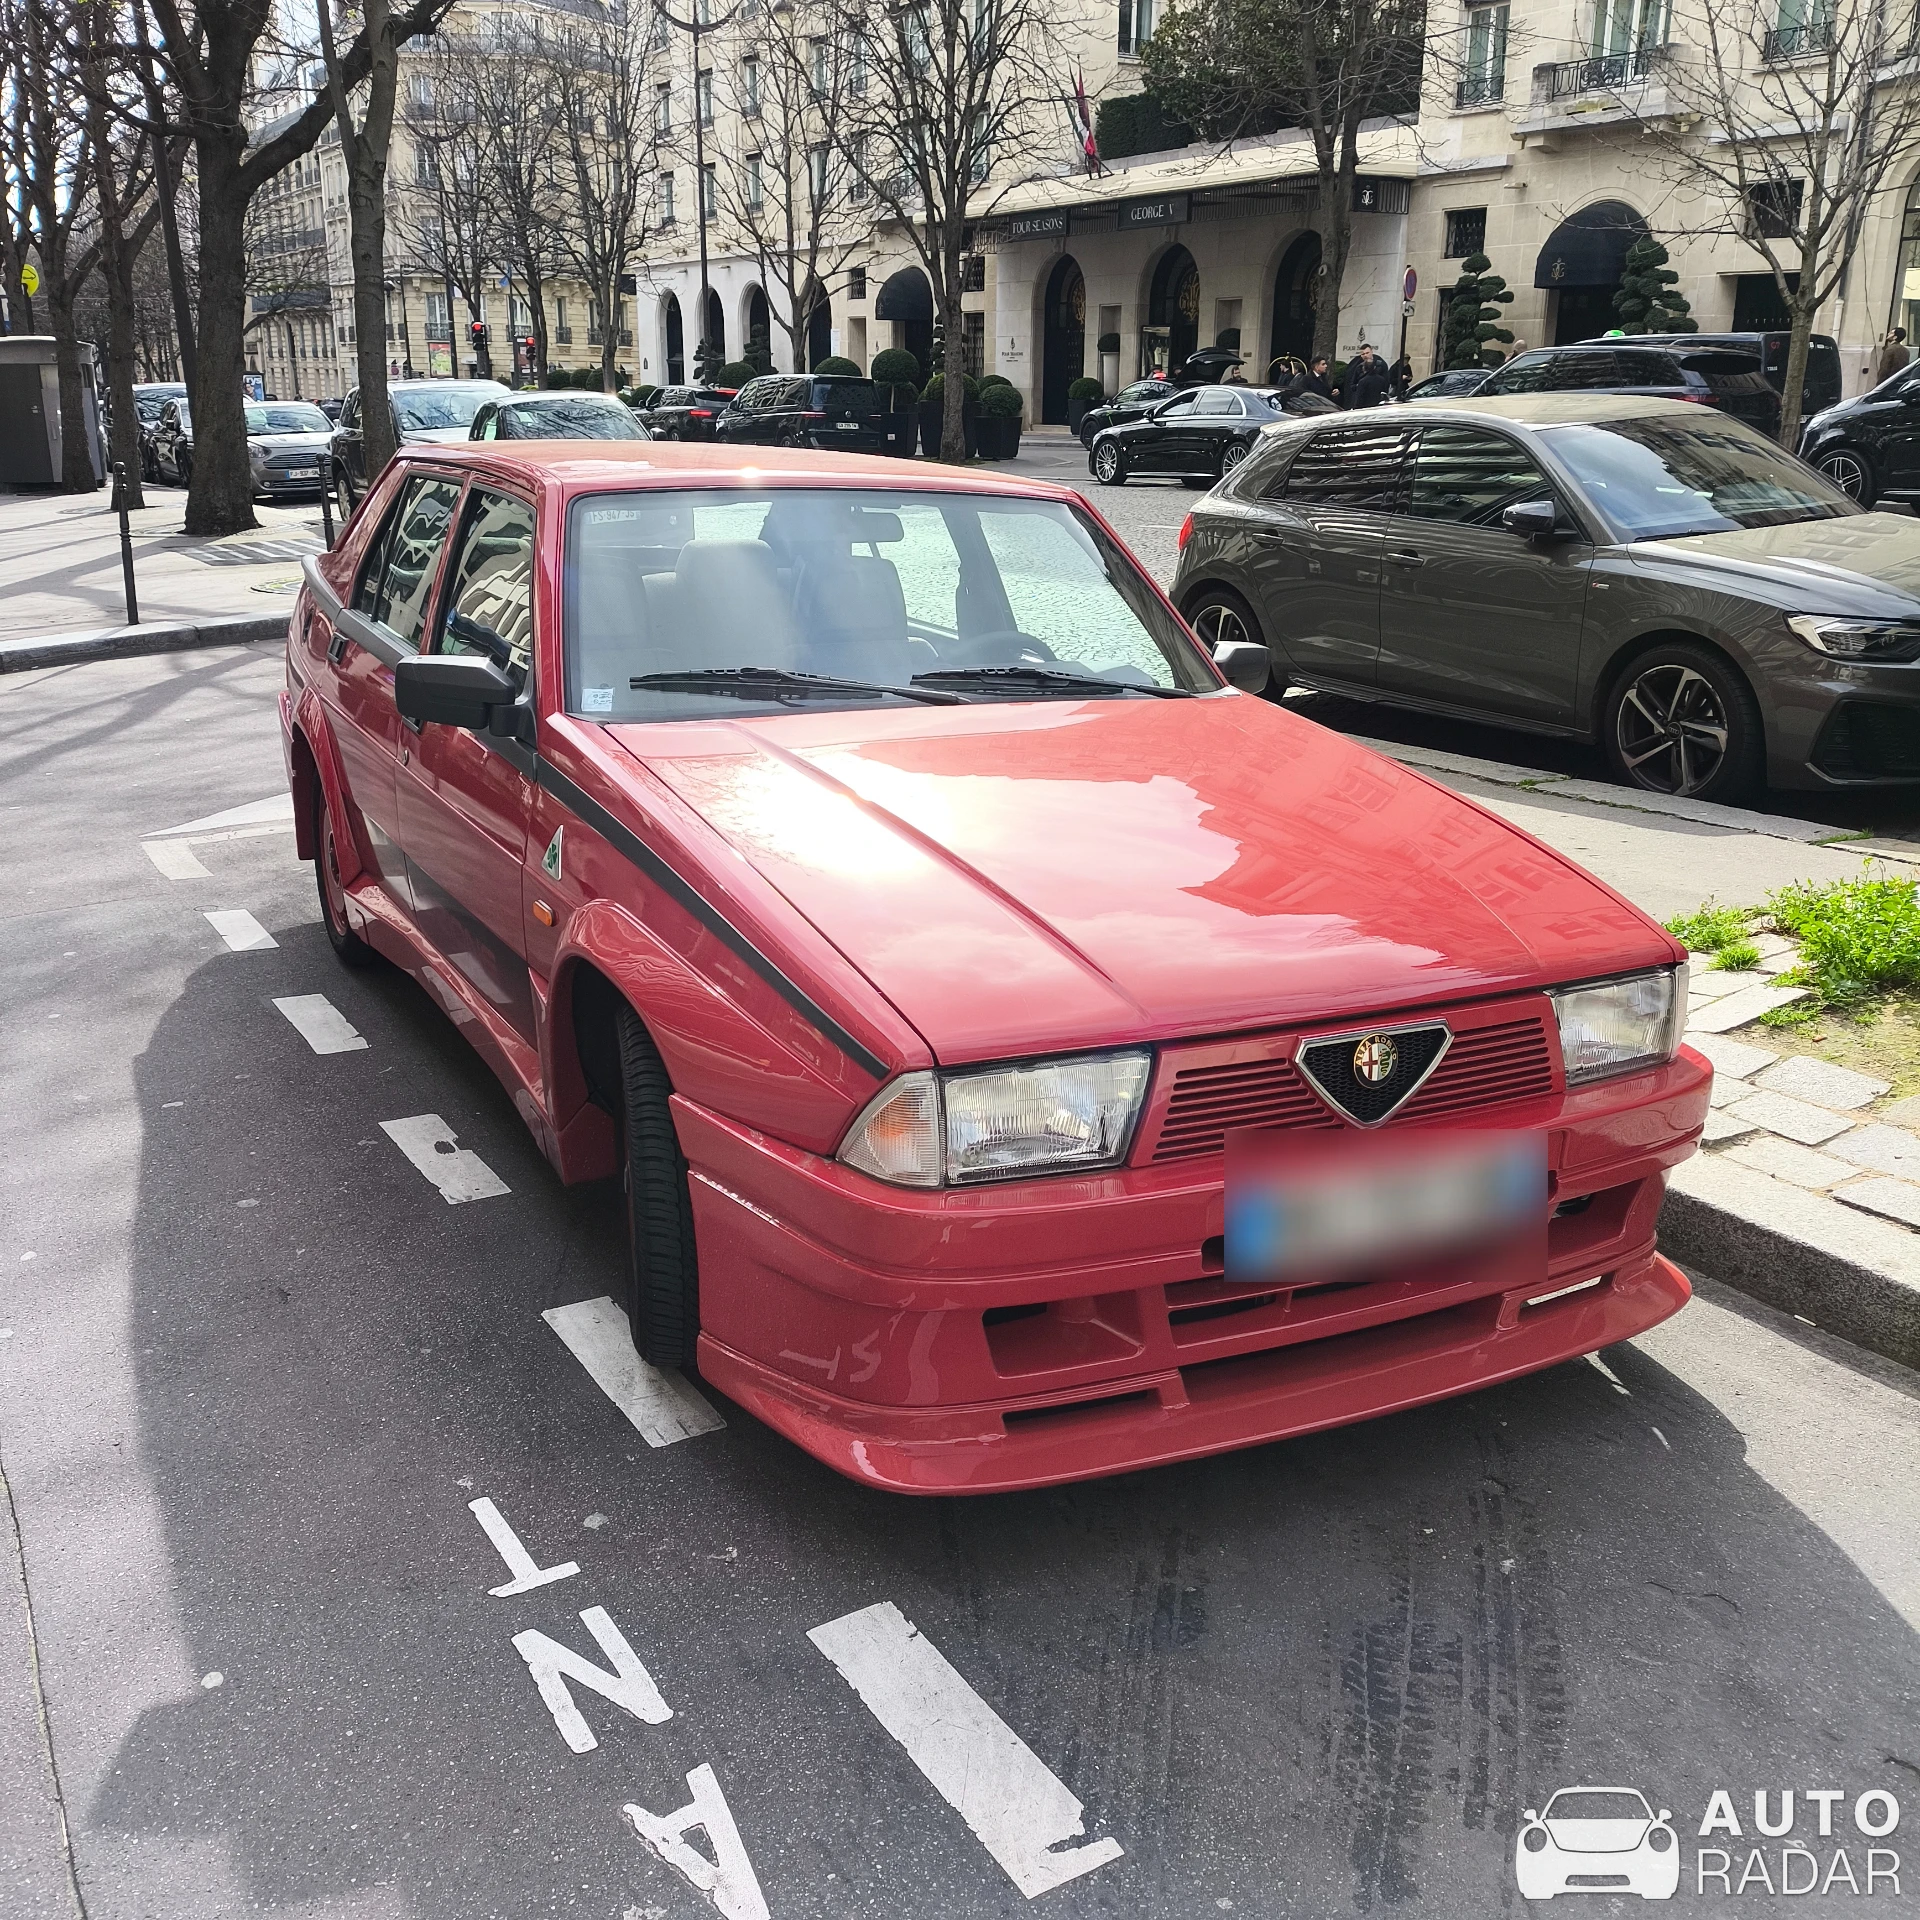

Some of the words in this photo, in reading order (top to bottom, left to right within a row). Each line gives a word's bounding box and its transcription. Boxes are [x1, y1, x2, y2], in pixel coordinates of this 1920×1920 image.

[1131, 204, 1164, 221] GEORGE
[1169, 203, 1174, 216] V
[1012, 220, 1031, 234] FOUR
[1032, 216, 1064, 233] SEASONS
[1355, 1040, 1372, 1067] ALFA
[1374, 1035, 1397, 1060] ROMEO
